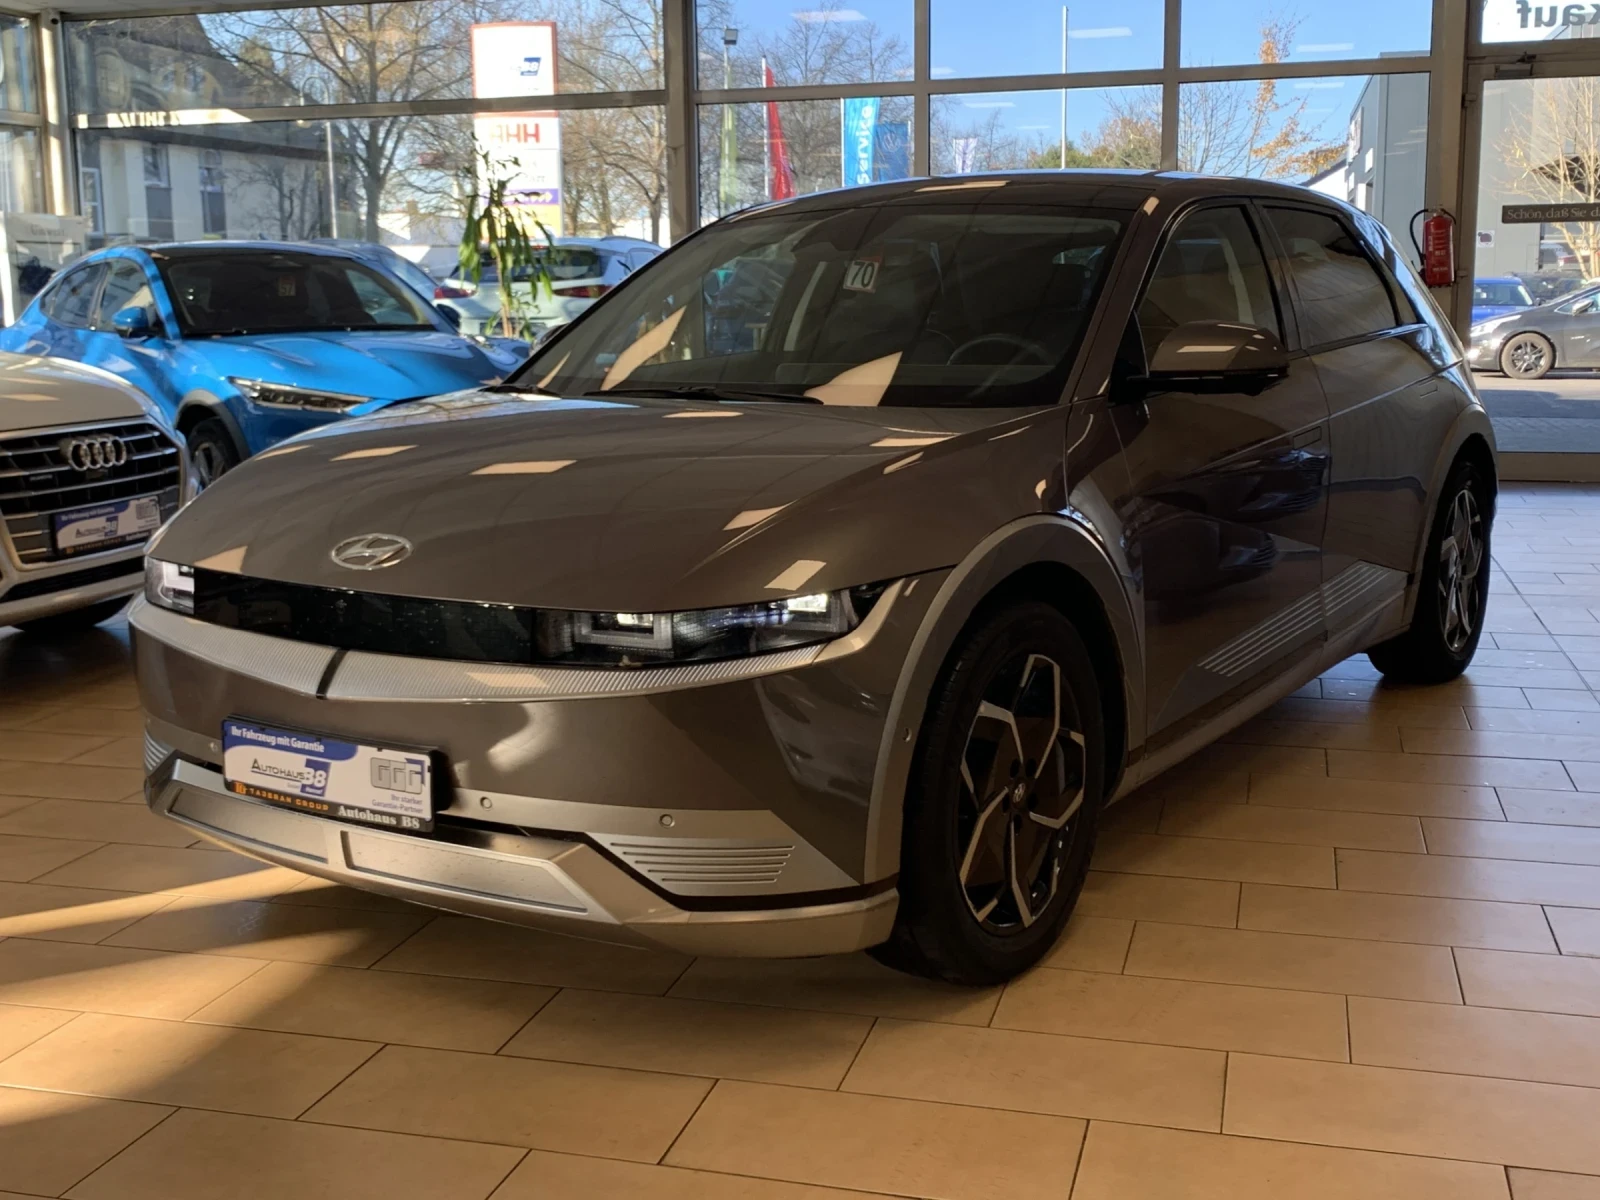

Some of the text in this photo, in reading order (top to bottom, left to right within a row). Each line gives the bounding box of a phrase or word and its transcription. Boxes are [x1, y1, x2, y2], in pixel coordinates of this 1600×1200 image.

[856, 105, 874, 184] Service
[1507, 206, 1600, 220] Schön, daß Sie d
[850, 261, 875, 288] 70
[231, 725, 325, 753] Ihr Fahrzeug mit Garantie
[338, 805, 397, 825] Autohaus
